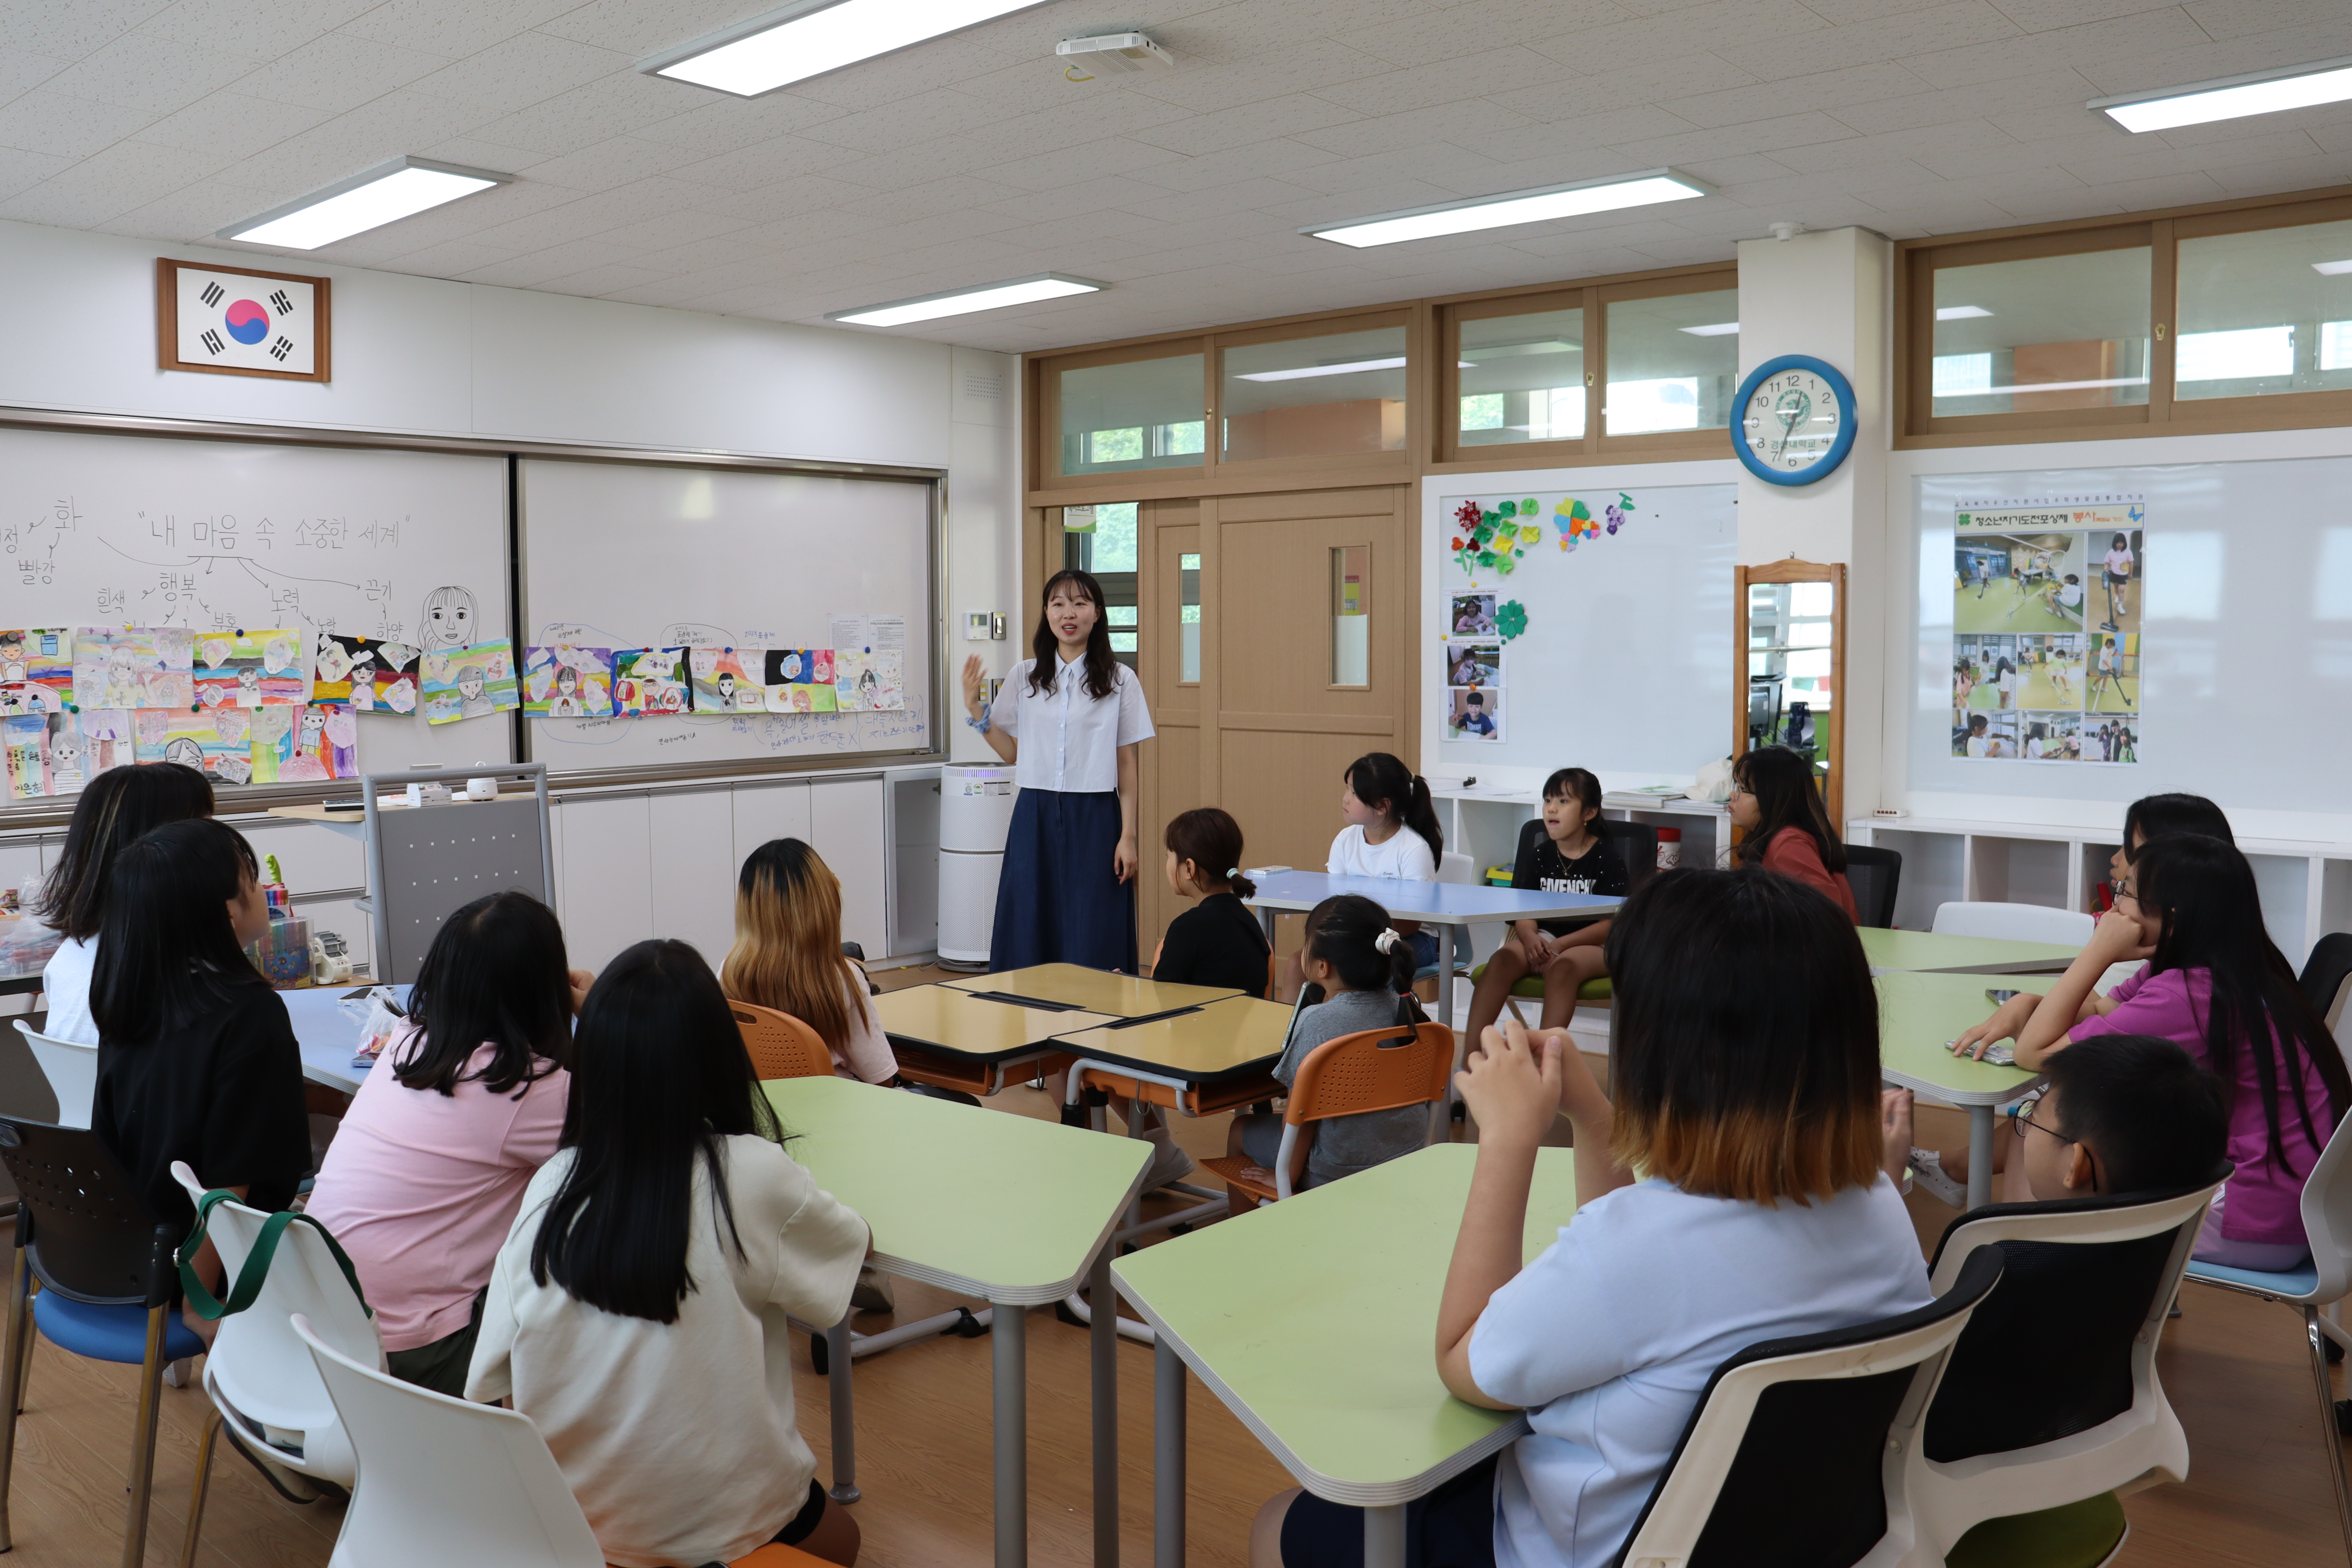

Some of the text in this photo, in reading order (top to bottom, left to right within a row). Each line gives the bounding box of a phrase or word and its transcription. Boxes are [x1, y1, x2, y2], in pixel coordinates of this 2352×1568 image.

[1769, 382, 1780, 392] 11
[1786, 376, 1799, 387] 12
[1809, 379, 1814, 390] 1
[1755, 396, 1768, 407] 10
[1822, 392, 1830, 403] 2
[1751, 417, 1759, 428] 9
[1828, 413, 1836, 424] 3
[1757, 437, 1764, 448] 8
[1821, 434, 1829, 445] 4
[1770, 452, 1779, 462] 7
[1807, 449, 1815, 460] 5
[1788, 456, 1797, 466] 6
[54, 496, 83, 532] 화
[1975, 513, 2068, 526] 청소년자기도전포상제
[194, 515, 239, 549] 마음
[256, 517, 275, 550] 속
[296, 517, 348, 550] 소중한
[0, 524, 18, 553] 정
[19, 559, 56, 584] 빨강
[160, 572, 197, 601] 행복
[365, 579, 391, 601] 끈기
[98, 587, 124, 613] 흰색
[271, 588, 299, 612] 노력
[317, 617, 336, 635] 노랑
[377, 621, 404, 641] 하양
